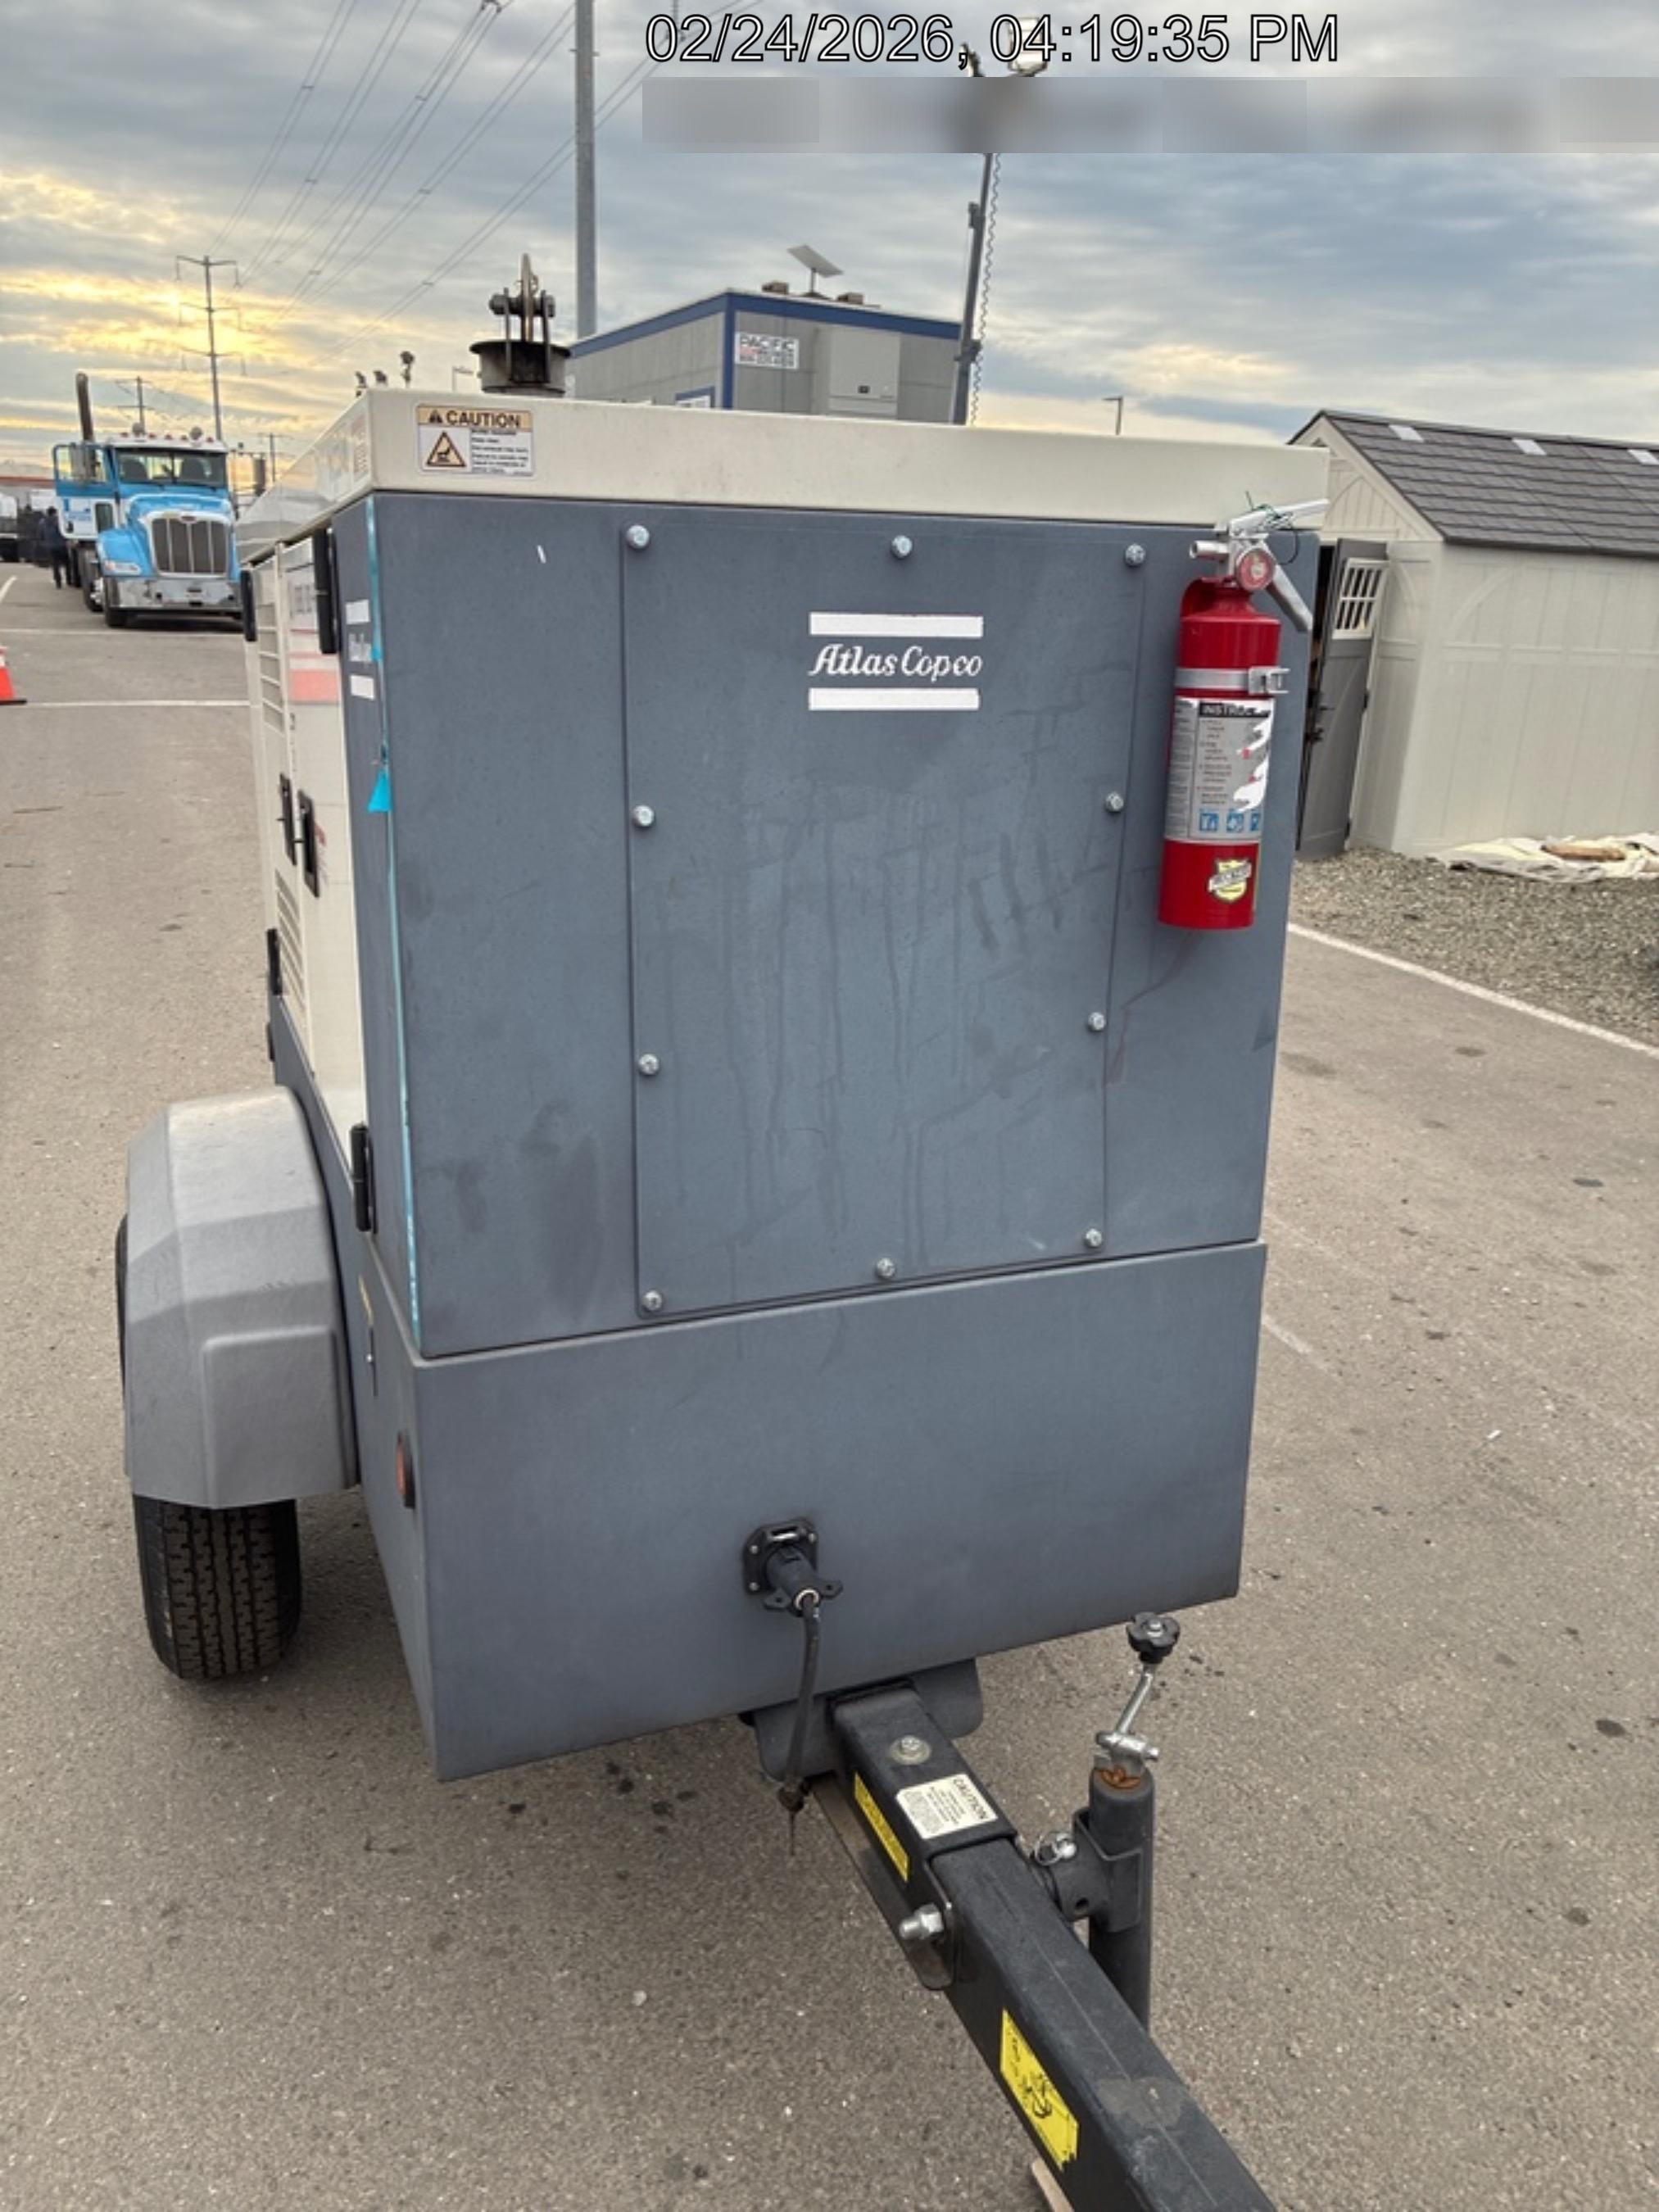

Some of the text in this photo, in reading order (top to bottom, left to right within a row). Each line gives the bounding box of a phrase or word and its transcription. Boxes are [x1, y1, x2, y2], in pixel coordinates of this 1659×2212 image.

[446, 410, 520, 428] CAUTION
[808, 643, 983, 682] Atlas Copco
